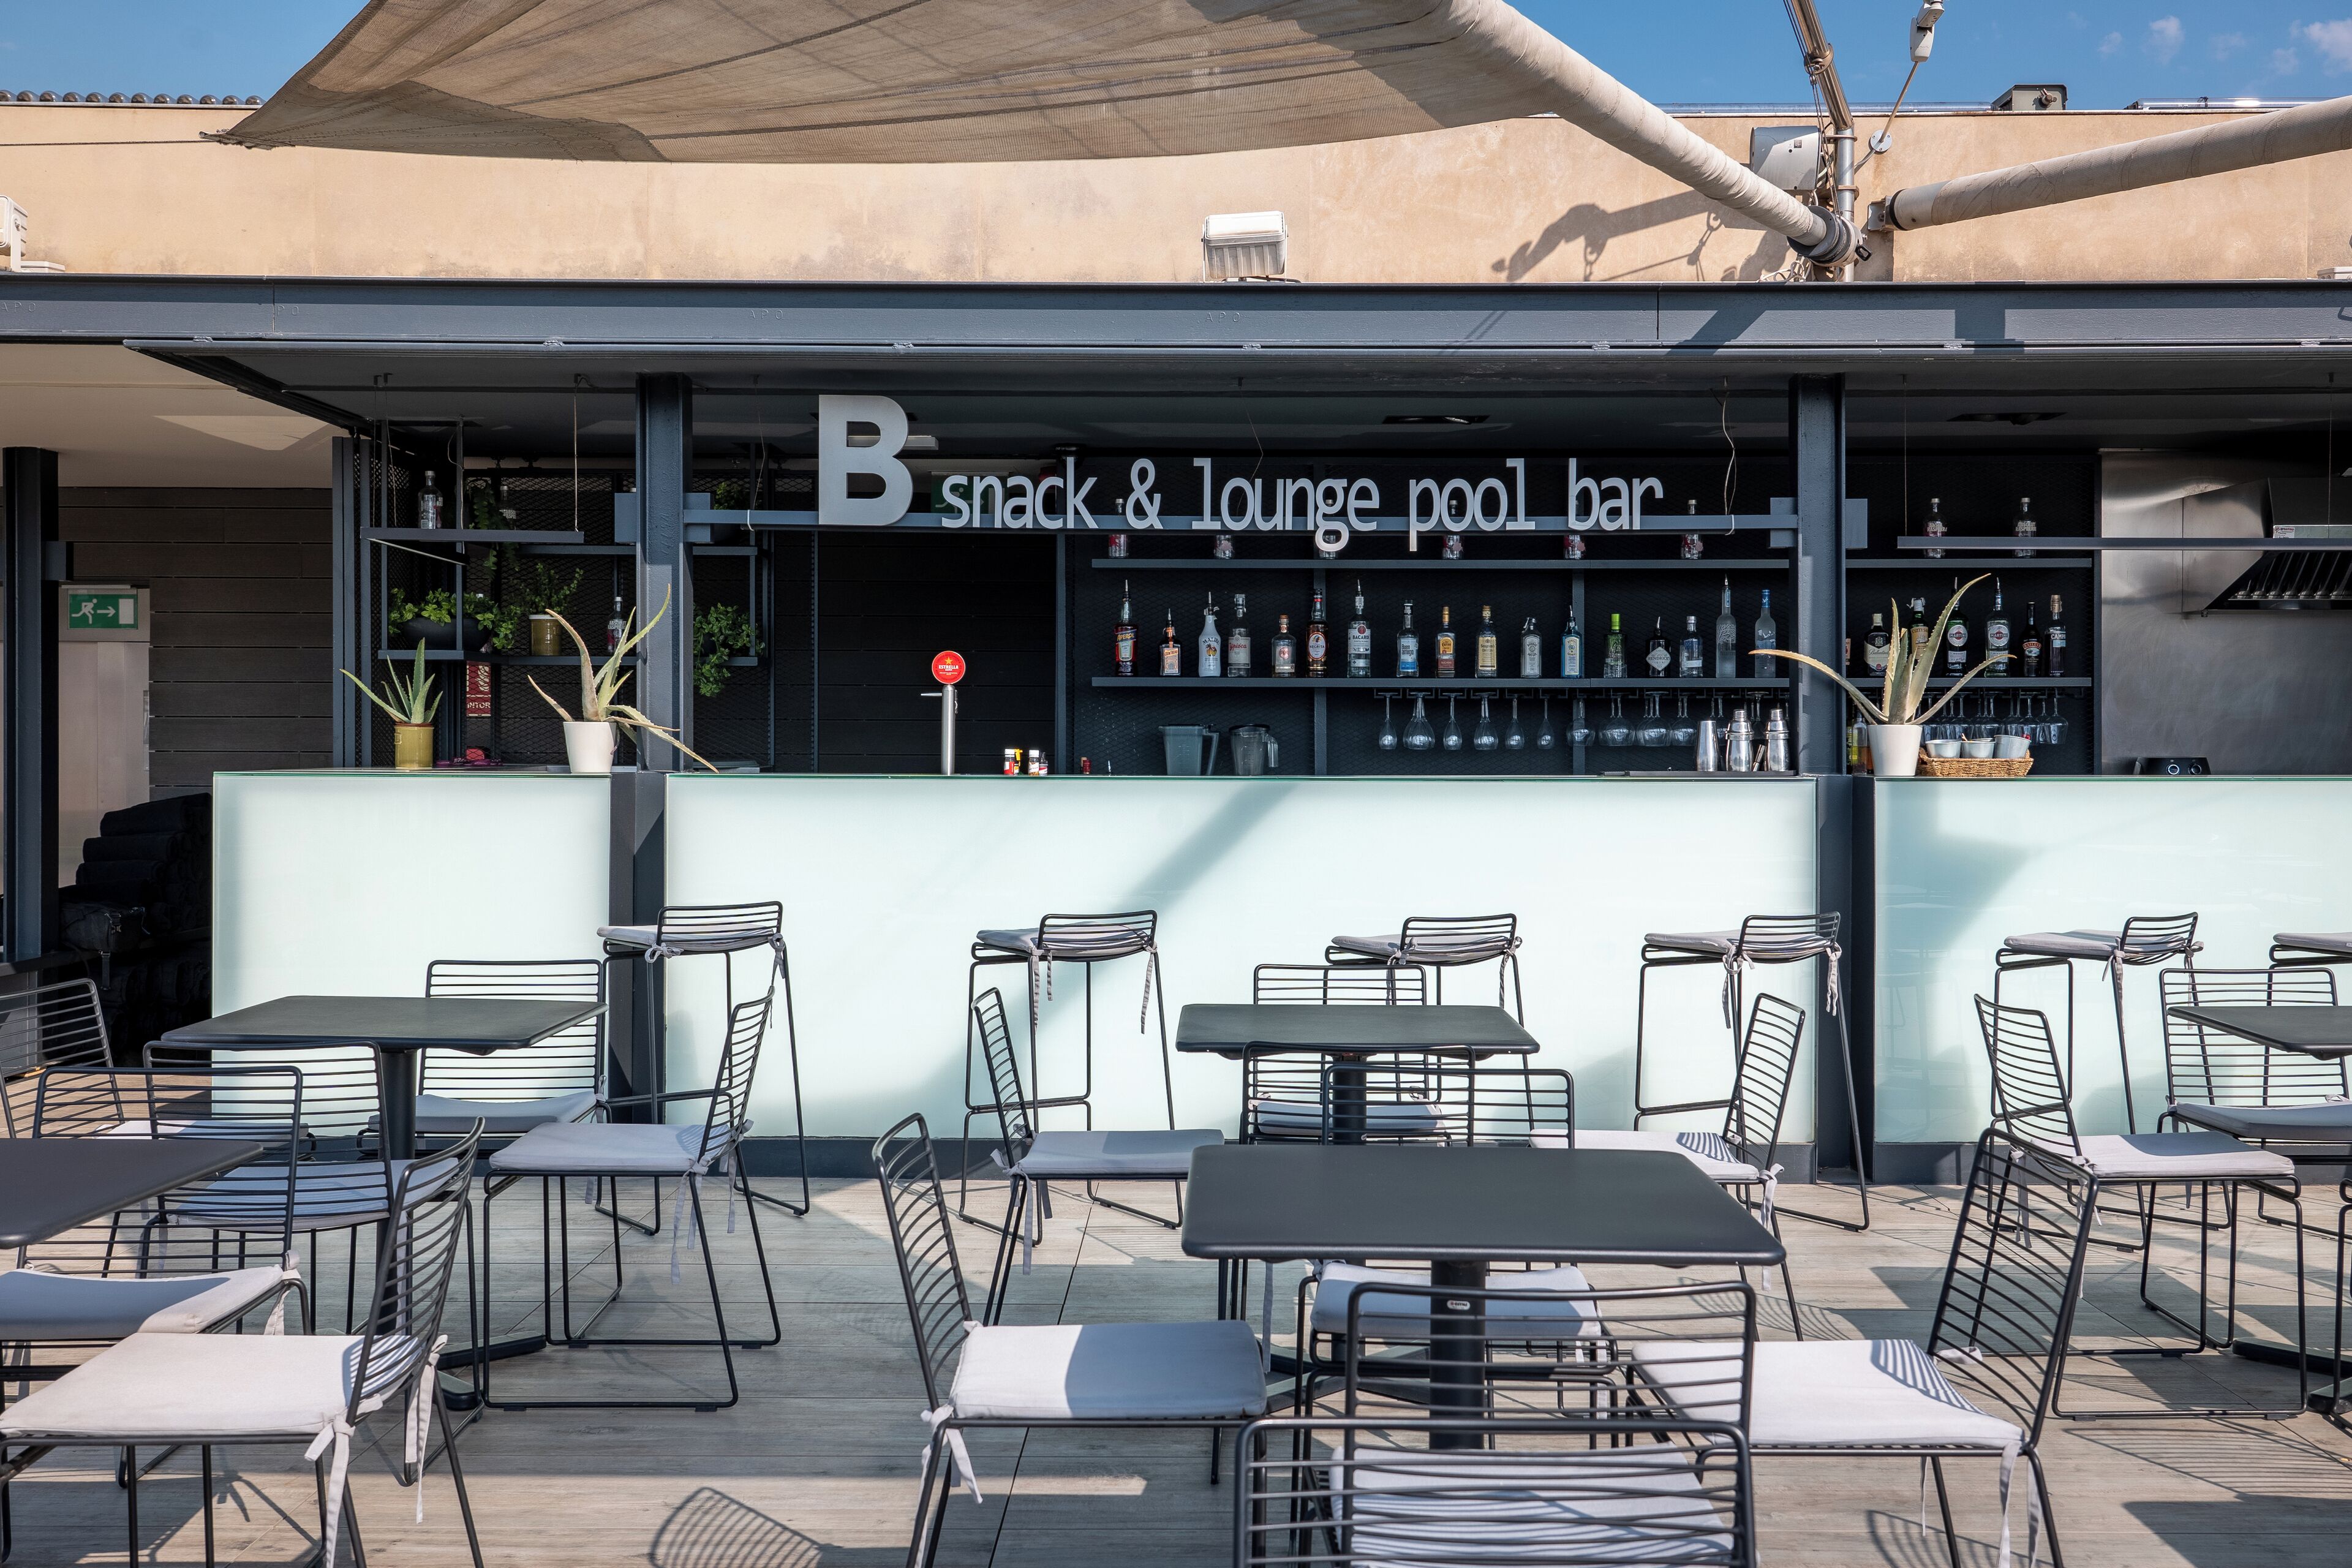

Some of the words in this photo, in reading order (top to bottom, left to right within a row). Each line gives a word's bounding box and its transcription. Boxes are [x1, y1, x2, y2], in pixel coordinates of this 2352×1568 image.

[819, 394, 913, 526] B
[941, 457, 1099, 529] snack
[1126, 458, 1163, 529] &
[1192, 458, 1379, 552] lounge
[1409, 458, 1536, 551] pool
[1568, 458, 1664, 530] bar
[1117, 633, 1134, 641] APEROL
